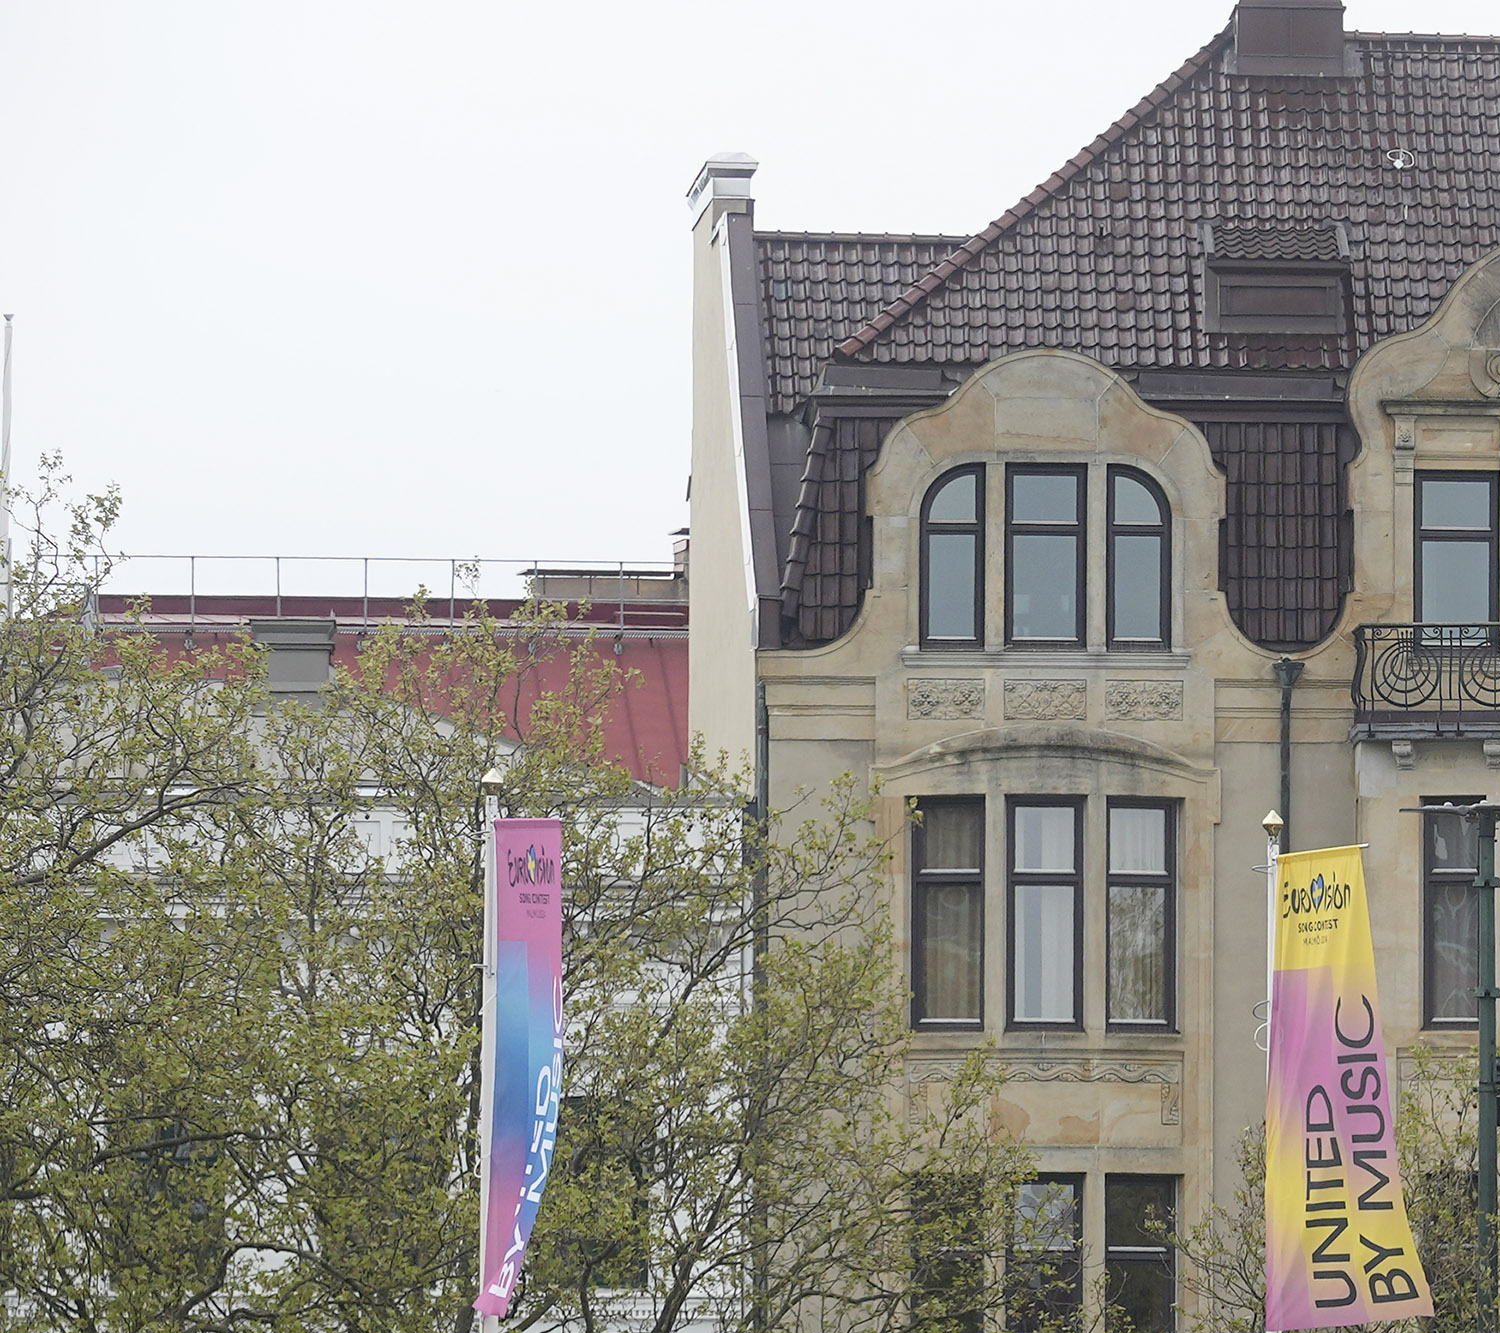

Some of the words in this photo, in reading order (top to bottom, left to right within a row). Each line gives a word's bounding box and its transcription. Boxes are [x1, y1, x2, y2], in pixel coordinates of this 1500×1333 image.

[1305, 1084, 1358, 1308] UNITED
[1335, 994, 1394, 1211] MUSIC
[1358, 1234, 1419, 1304] BY
